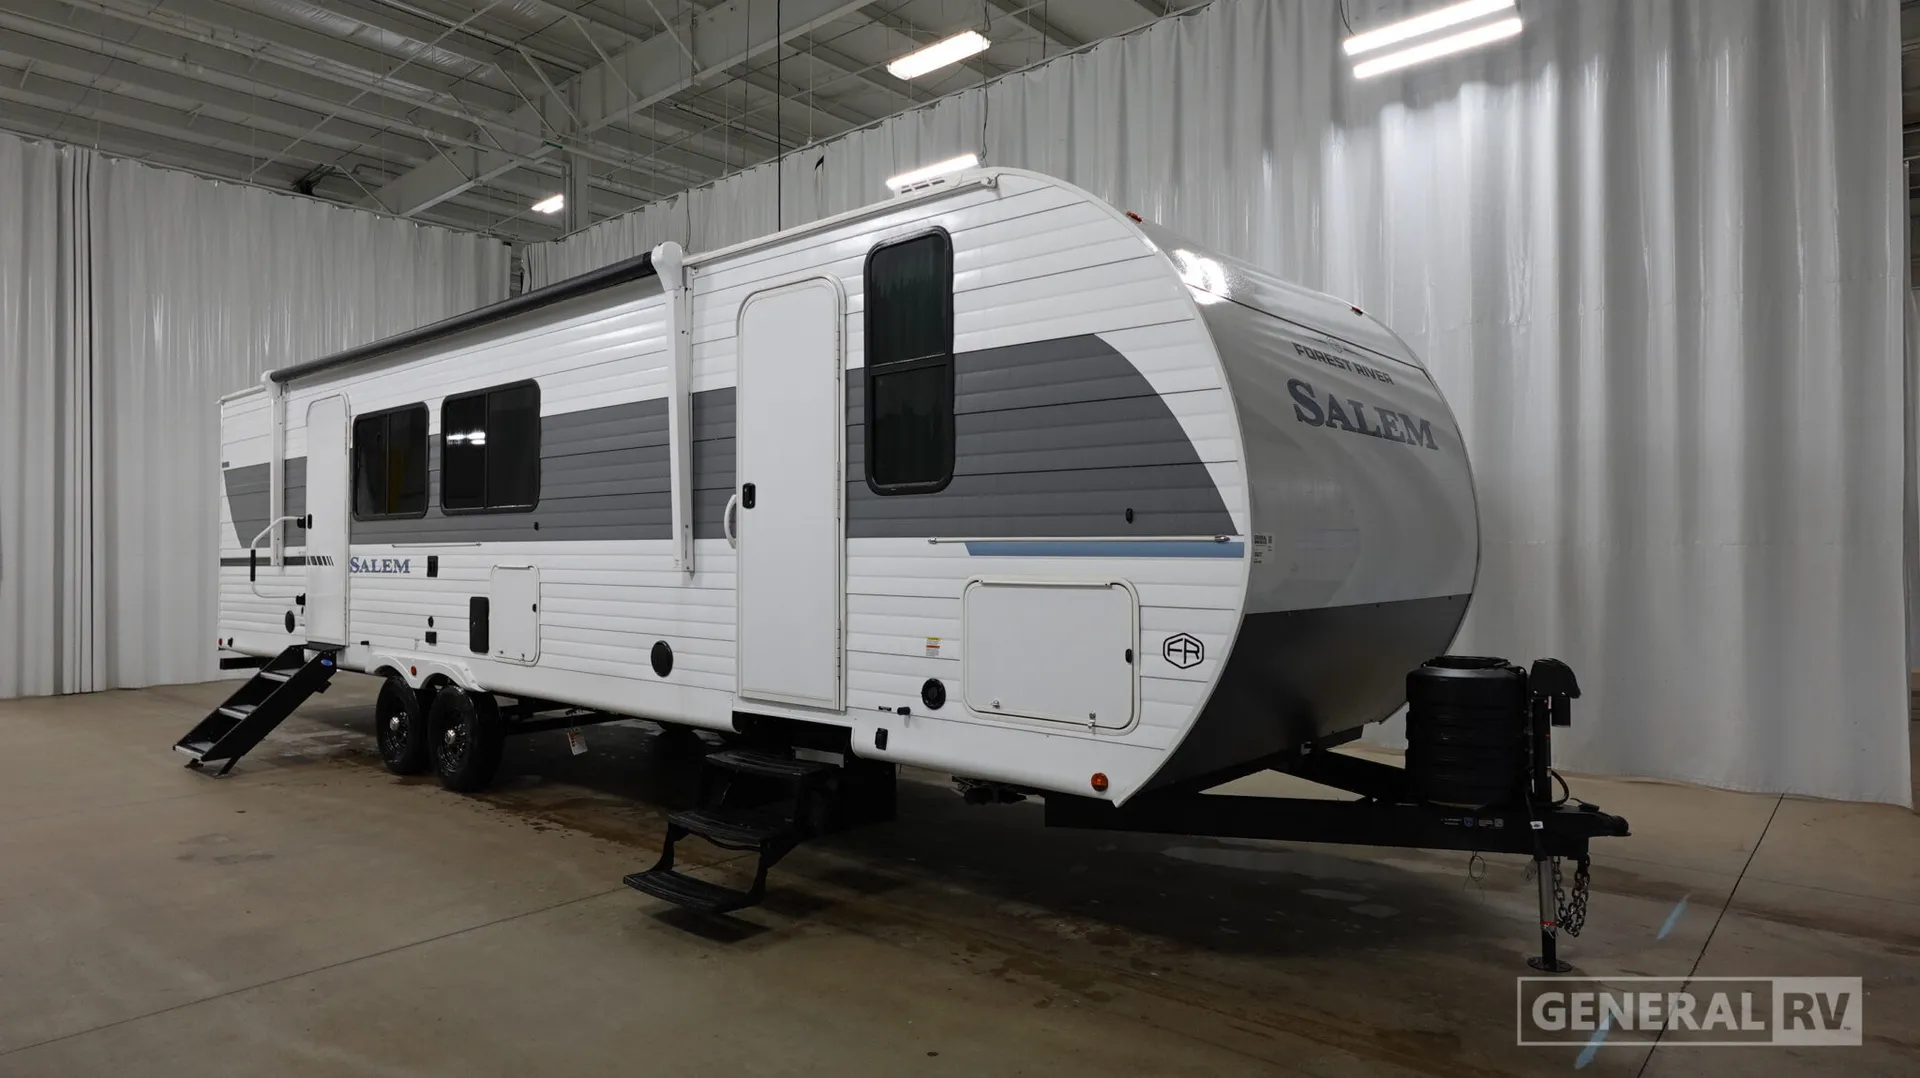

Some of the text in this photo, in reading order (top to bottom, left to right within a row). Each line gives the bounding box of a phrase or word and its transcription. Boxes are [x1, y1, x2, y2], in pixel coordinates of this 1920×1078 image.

[1291, 341, 1395, 386] FOREST RIVER
[1286, 378, 1439, 451] SALEM
[349, 556, 411, 574] SALEM
